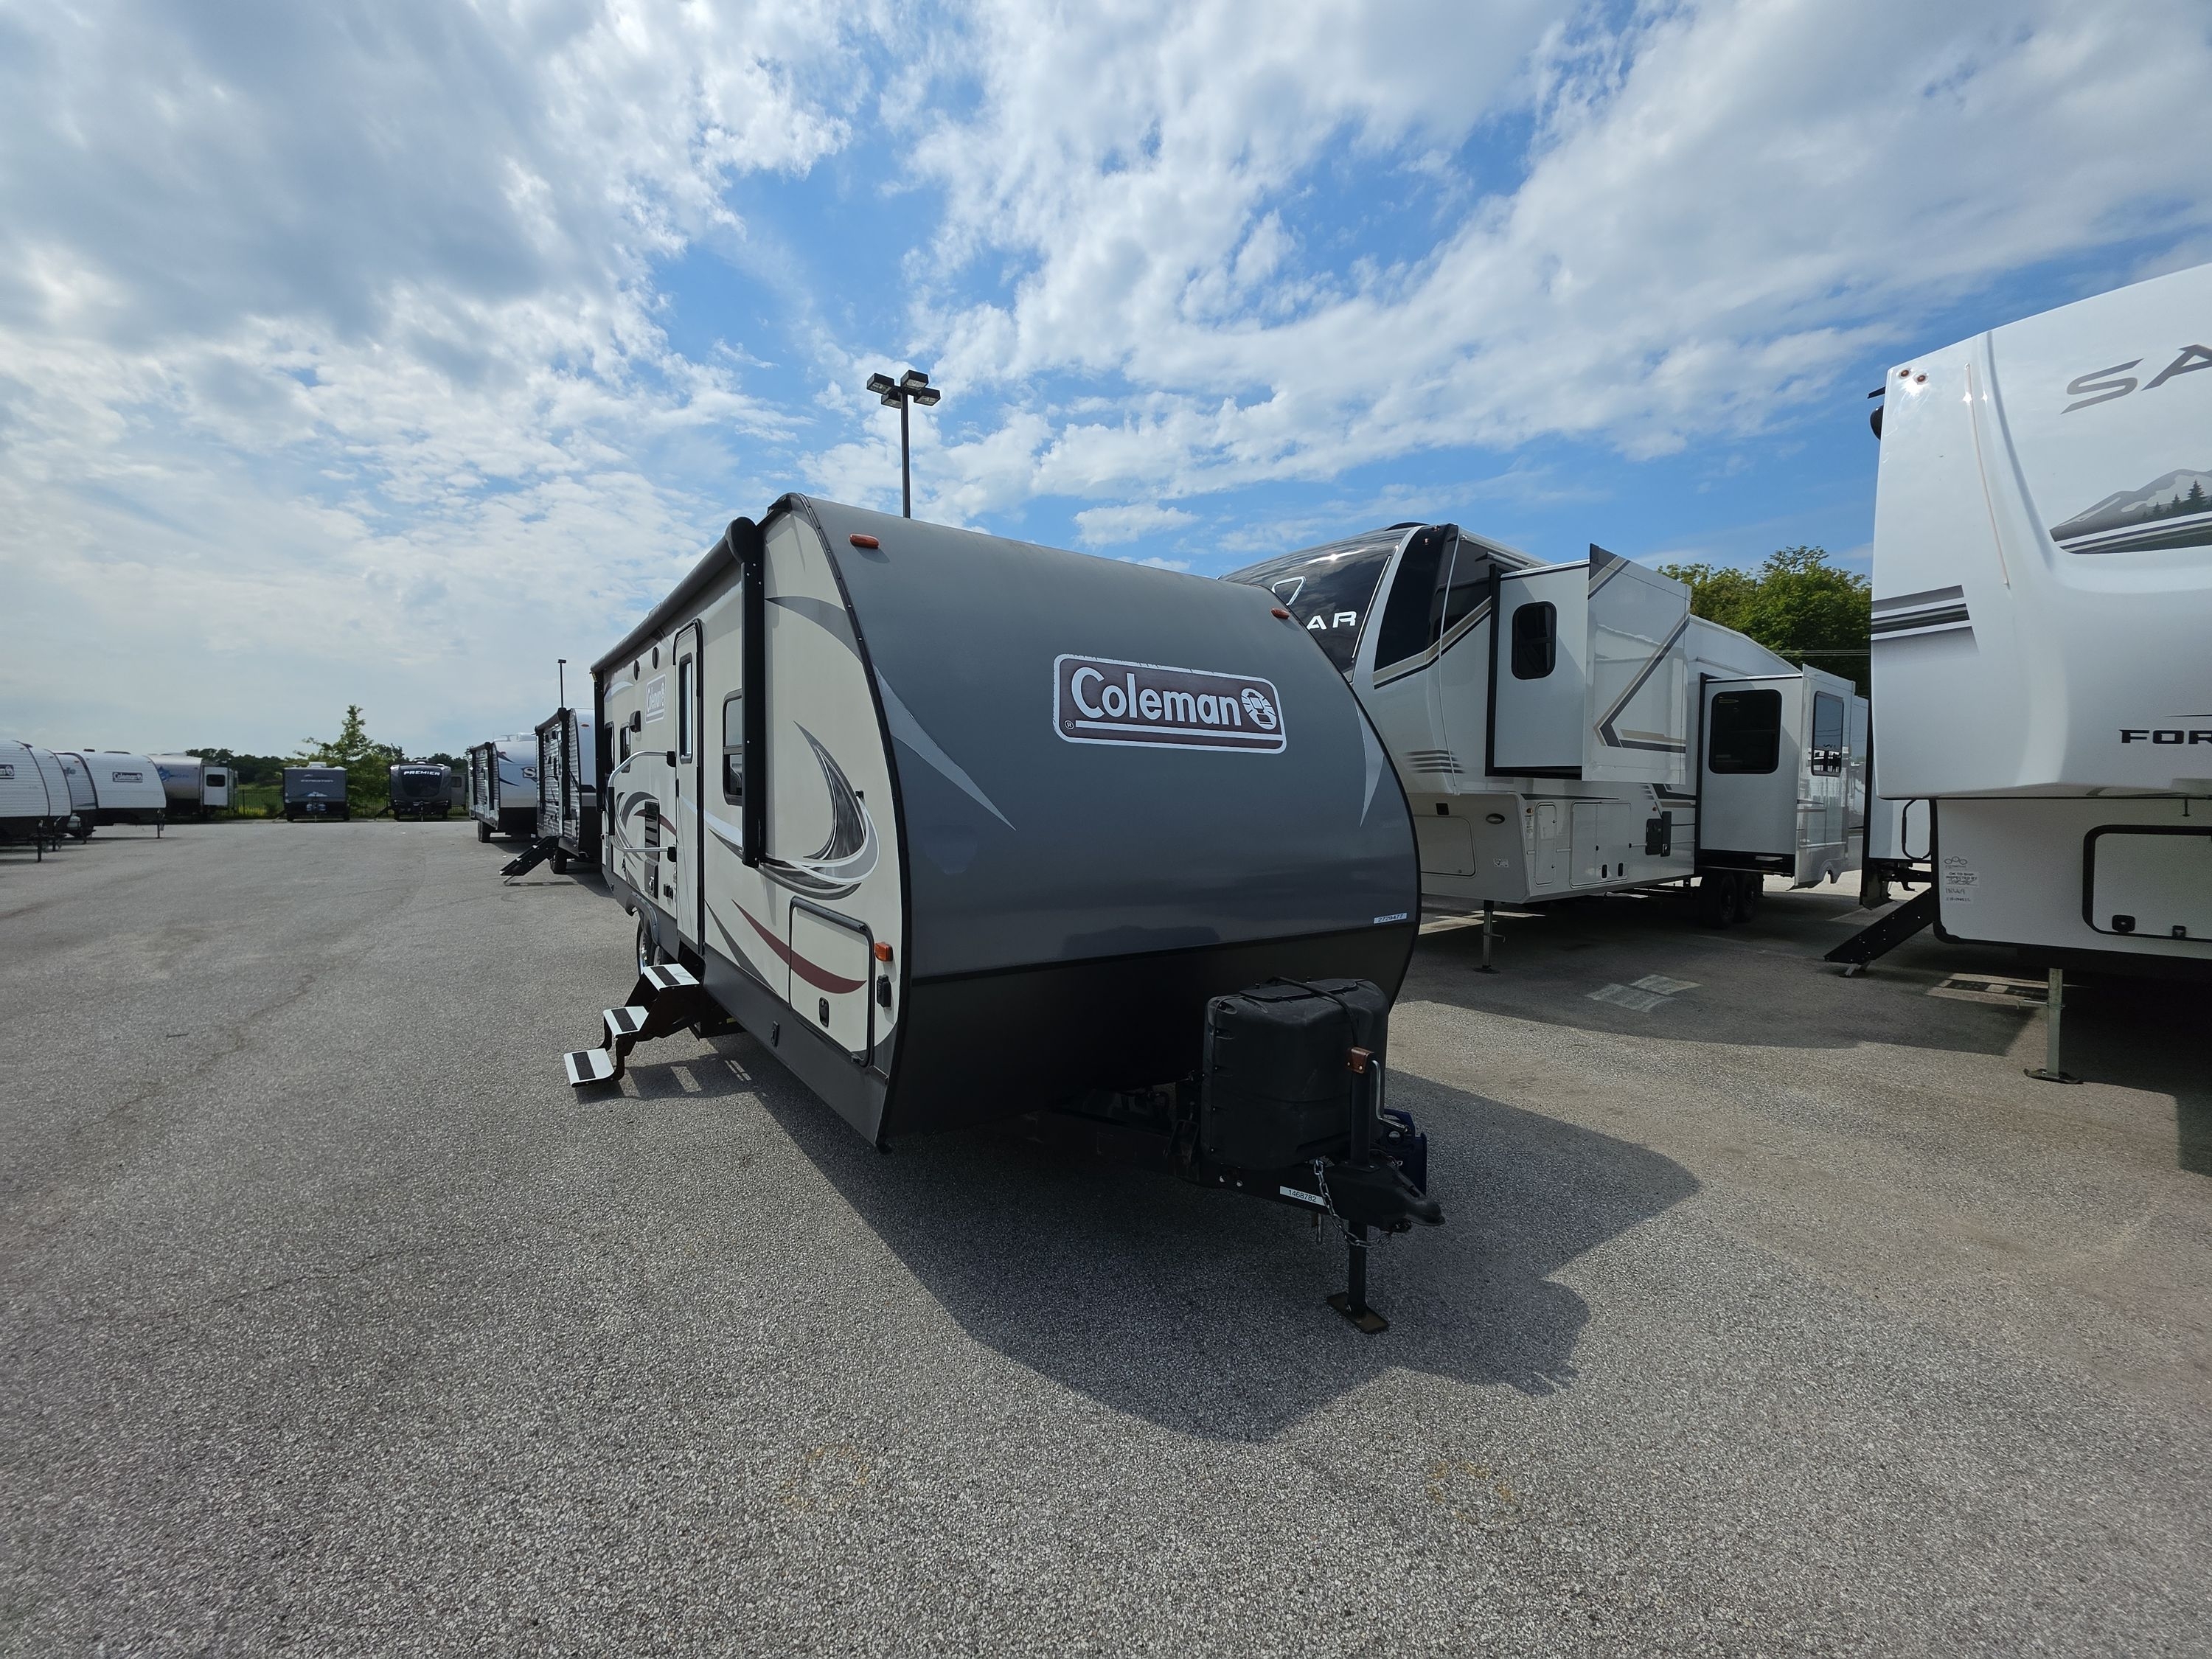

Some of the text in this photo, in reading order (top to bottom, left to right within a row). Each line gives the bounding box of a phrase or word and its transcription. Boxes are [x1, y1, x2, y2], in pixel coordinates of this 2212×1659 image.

[2060, 344, 2212, 414] SA
[1306, 611, 1357, 630] AR
[647, 686, 661, 713] Coleman
[1071, 667, 1242, 726] Coleman
[2118, 729, 2212, 745] FOR
[1288, 1189, 1317, 1203] 1468782
